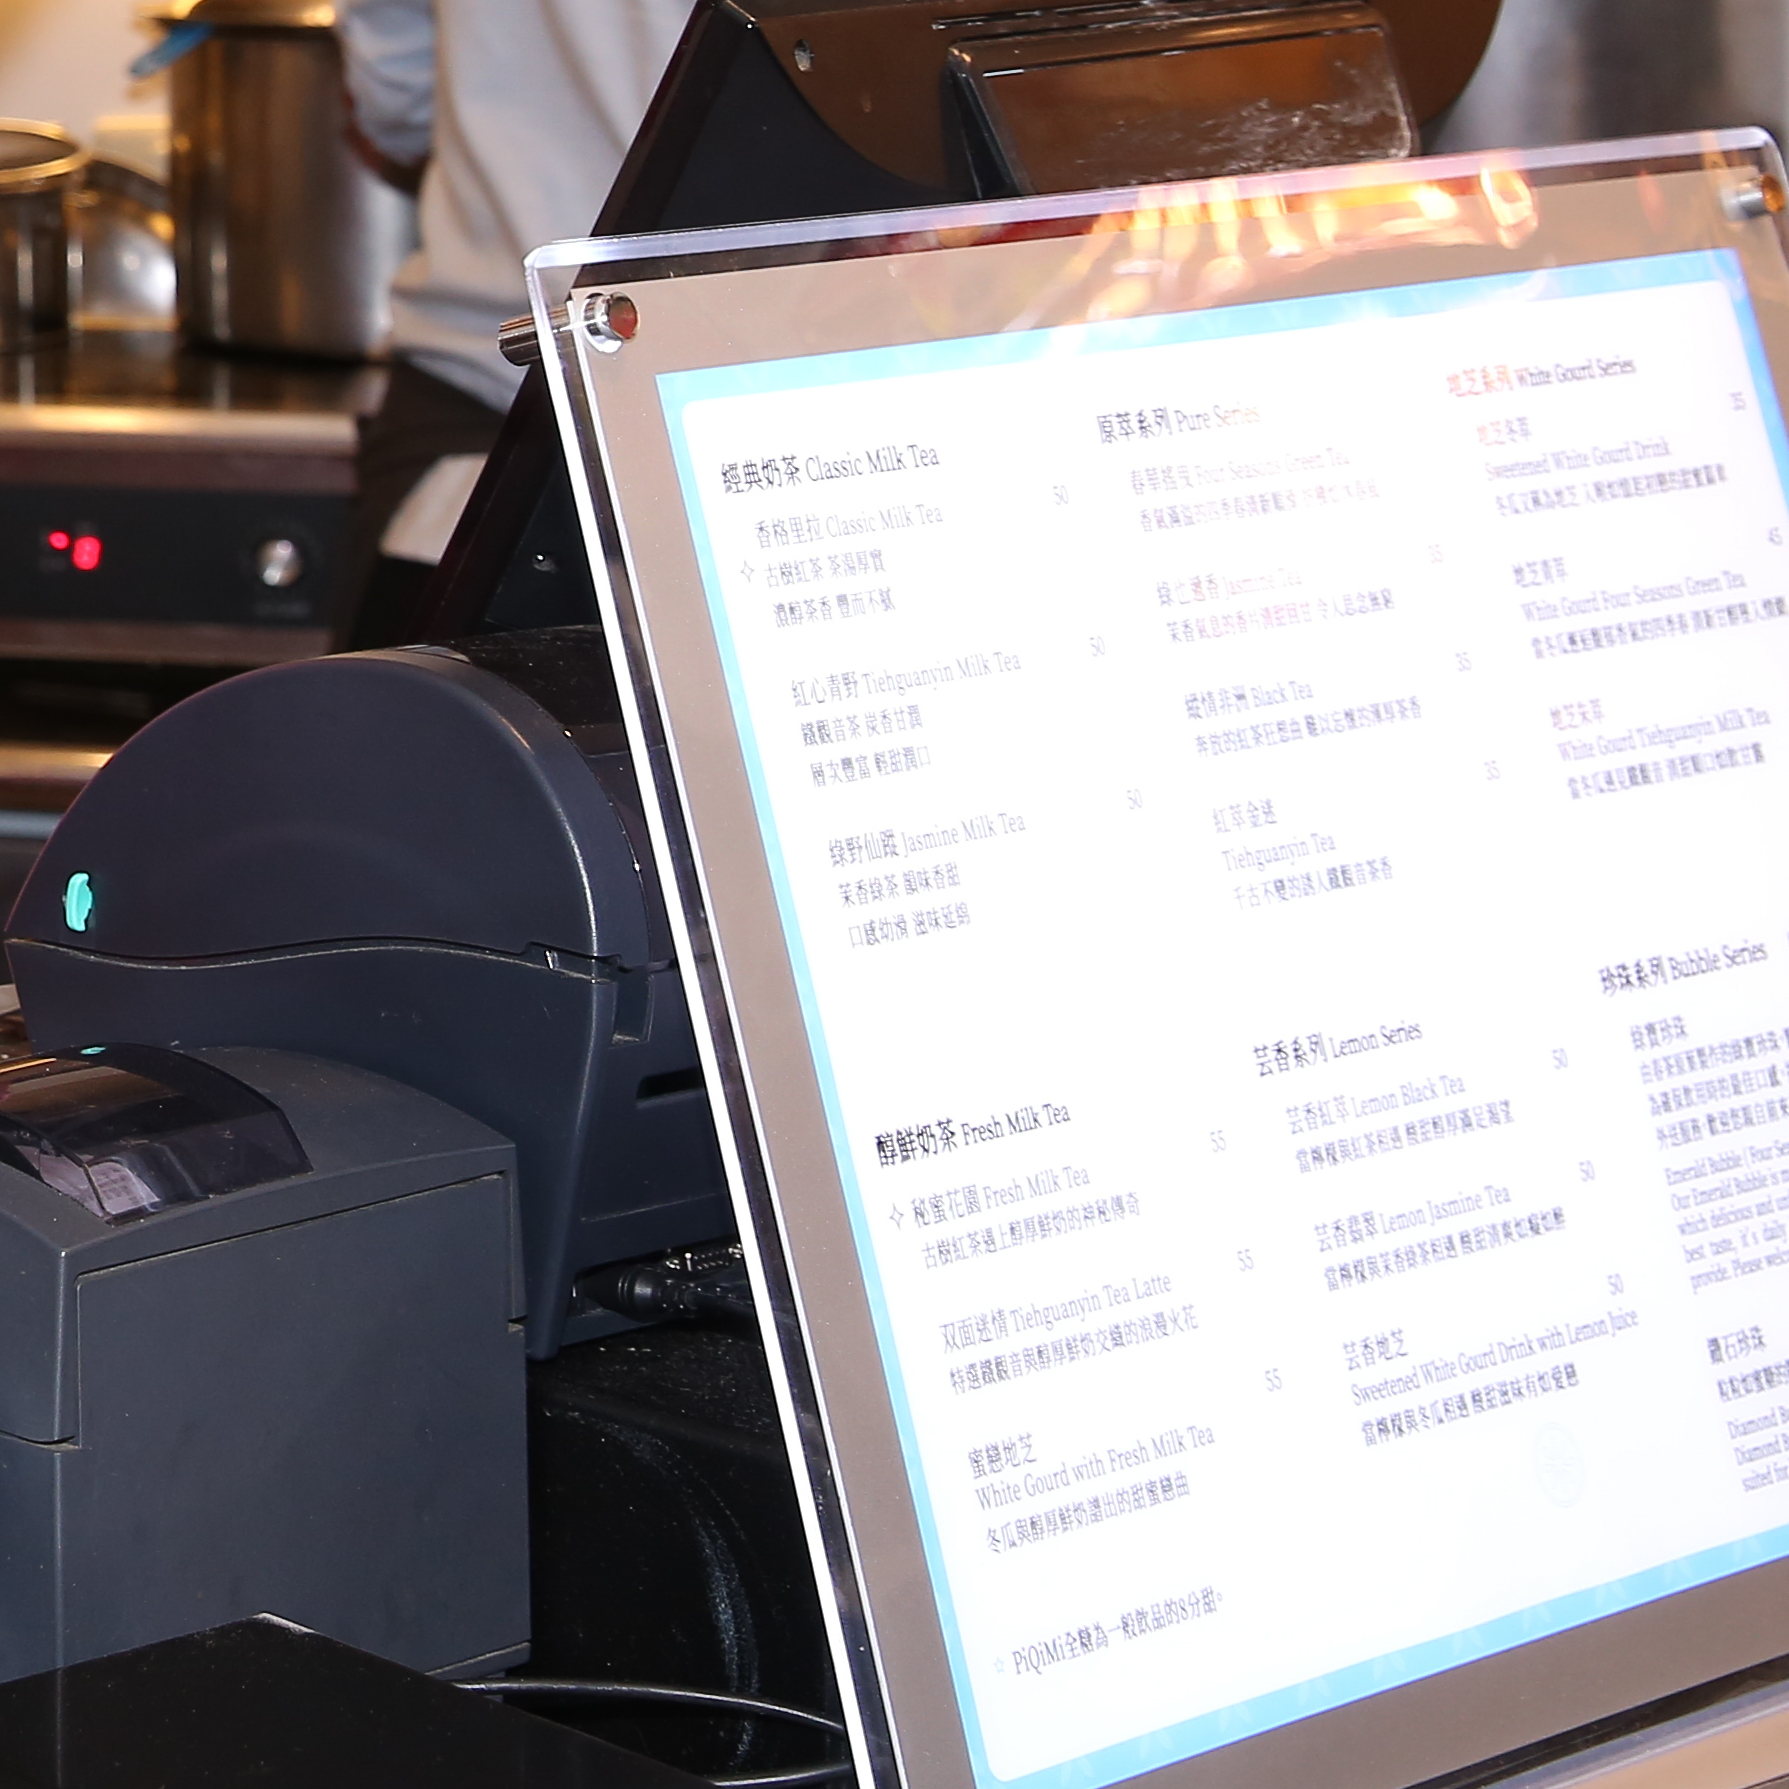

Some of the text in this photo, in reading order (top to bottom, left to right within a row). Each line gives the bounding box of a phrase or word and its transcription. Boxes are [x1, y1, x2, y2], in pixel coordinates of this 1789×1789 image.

[1446, 356, 1636, 396] 地芝系列 White Gourd Series
[1097, 405, 1257, 442] 原萃系列 Pure Series
[721, 445, 938, 492] 經典奶茶 Classic Milk Tea
[1485, 436, 1672, 480] Sweetened White Gourd Drink
[1053, 485, 1068, 504] 50
[754, 504, 942, 547] 香格里拉 Classic Milk Tea
[764, 548, 886, 587] 古樹紅茶 茶湯厚實
[1520, 570, 1746, 620] White Gourd Four Seasons Green Tea
[1089, 636, 1104, 656] 50
[791, 652, 1020, 706] 紅心青野 Tiehguanyin Milk Tea
[1250, 683, 1287, 707] Black
[1288, 681, 1312, 699] Tea
[1557, 706, 1772, 760] White Gourd Tiehguanyin Milk Tea
[810, 755, 870, 786] 層次豐富
[1127, 789, 1141, 809] 50
[829, 813, 1025, 866] 綠野仙蹤 Jasmine Milk Tea
[1221, 833, 1335, 871] Tiehguanyin Tea
[838, 874, 898, 906] 茉香綠茶
[1599, 941, 1767, 993] 珍珠系列 Bubble Series
[1253, 1021, 1421, 1075] 芸香系列 Lemon Series
[1551, 1048, 1567, 1069] 50
[1350, 1093, 1398, 1117] Lemon
[1399, 1078, 1438, 1105] Black
[1439, 1075, 1465, 1095] Tea
[875, 1104, 1069, 1166] 醇鮮奶茶 Fresh Milk Tea
[1210, 1130, 1225, 1152] 55
[983, 1179, 1026, 1209] Fresh
[1026, 1169, 1060, 1197] Milk
[1062, 1166, 1089, 1187] Tea
[1579, 1160, 1594, 1181] 50
[1379, 1209, 1426, 1233] Lemon
[1427, 1192, 1482, 1225] Jasmine
[1484, 1185, 1510, 1205] Tea
[1237, 1249, 1253, 1271] 55
[1009, 1290, 1101, 1331] Tiehguanyin
[1102, 1284, 1130, 1306] Tea
[1132, 1276, 1170, 1298] Latte
[1607, 1273, 1623, 1295] 50
[1343, 1328, 1407, 1370] 芸香地芝
[1351, 1308, 1638, 1405] Sweetened White Gourd Drink with Lemon Juice
[1265, 1368, 1281, 1391] 55
[968, 1434, 1036, 1478] 蜜戀地芝
[975, 1426, 1214, 1509] White Gourd with Fresh Milk Tea
